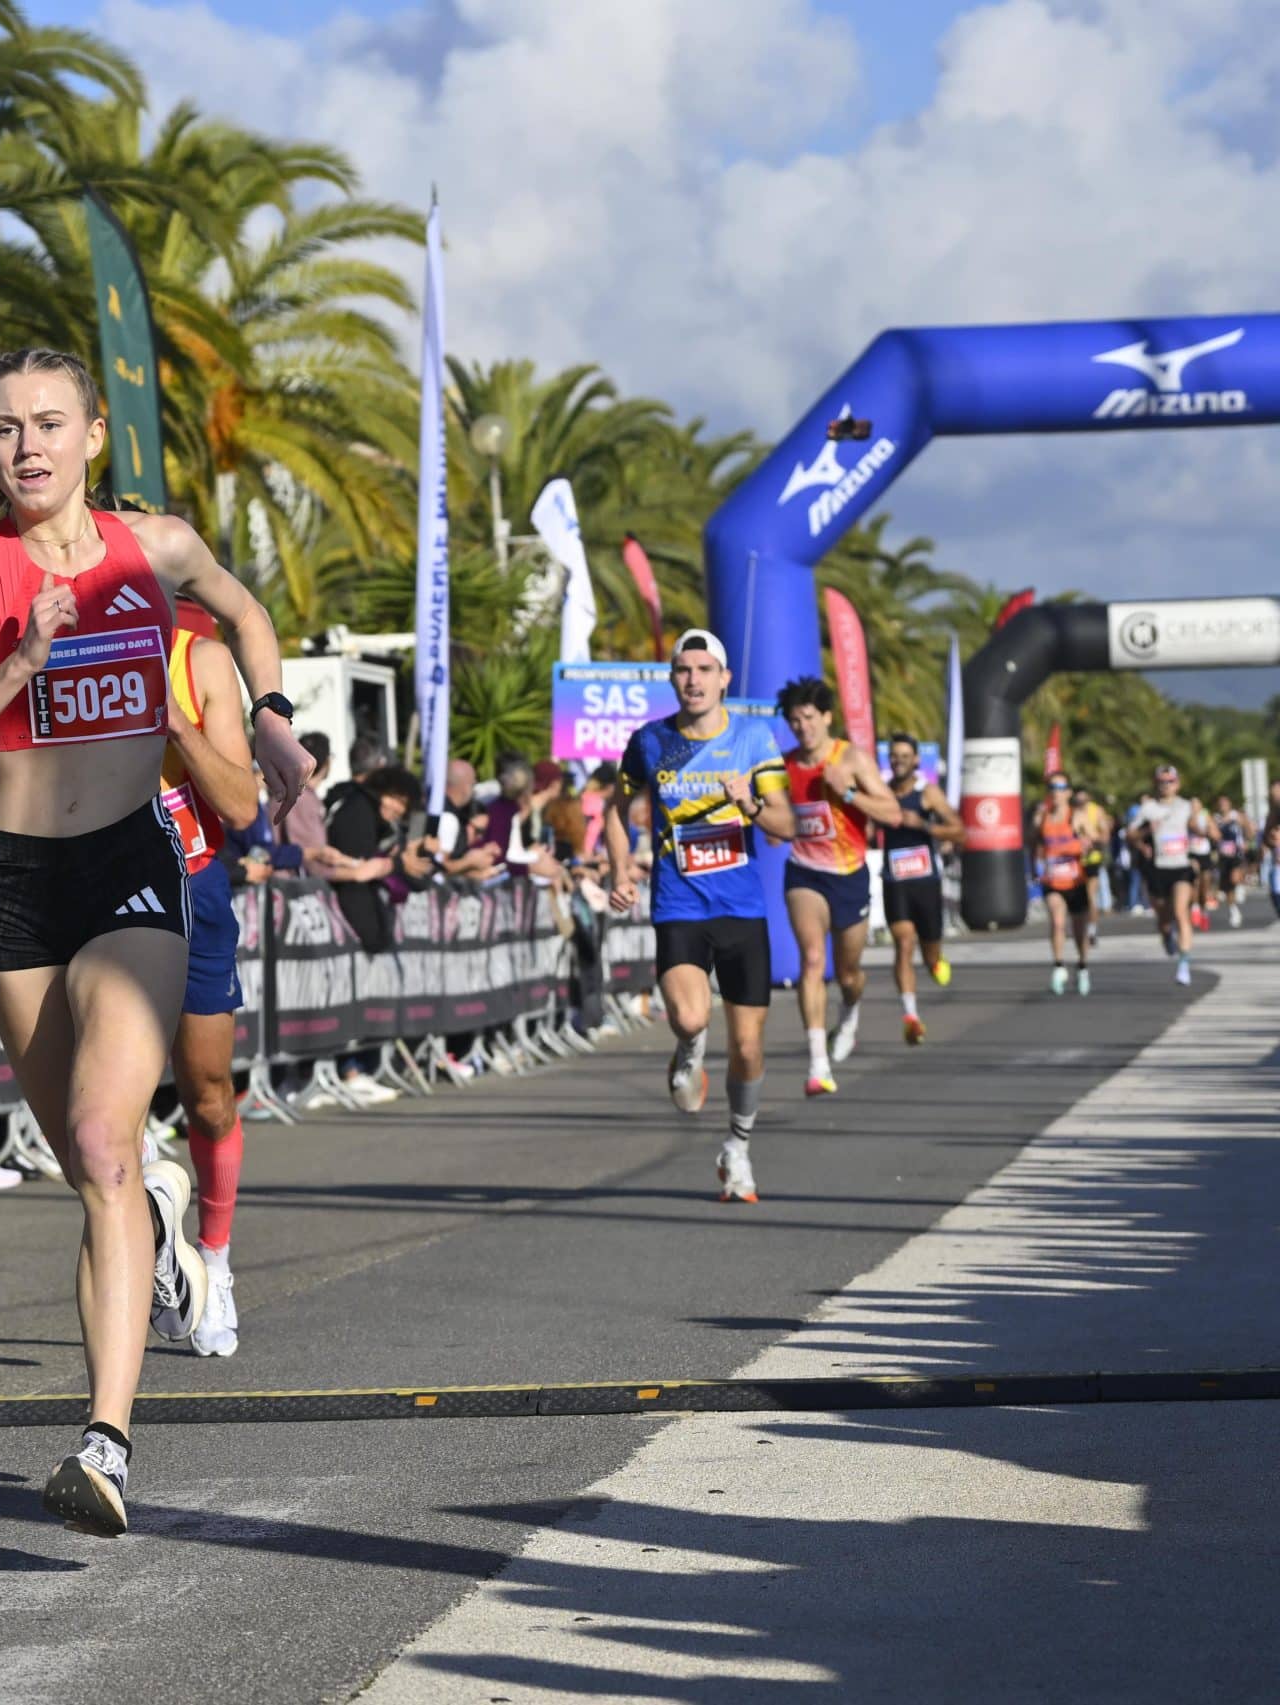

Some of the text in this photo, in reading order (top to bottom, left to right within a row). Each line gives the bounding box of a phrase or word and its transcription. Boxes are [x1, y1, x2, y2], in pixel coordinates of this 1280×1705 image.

[50, 638, 154, 659] ERES RUNNING DAYS
[36, 675, 51, 734] ELITE
[52, 671, 147, 724] 5029
[582, 683, 649, 717] SAS
[575, 718, 646, 751] PRE
